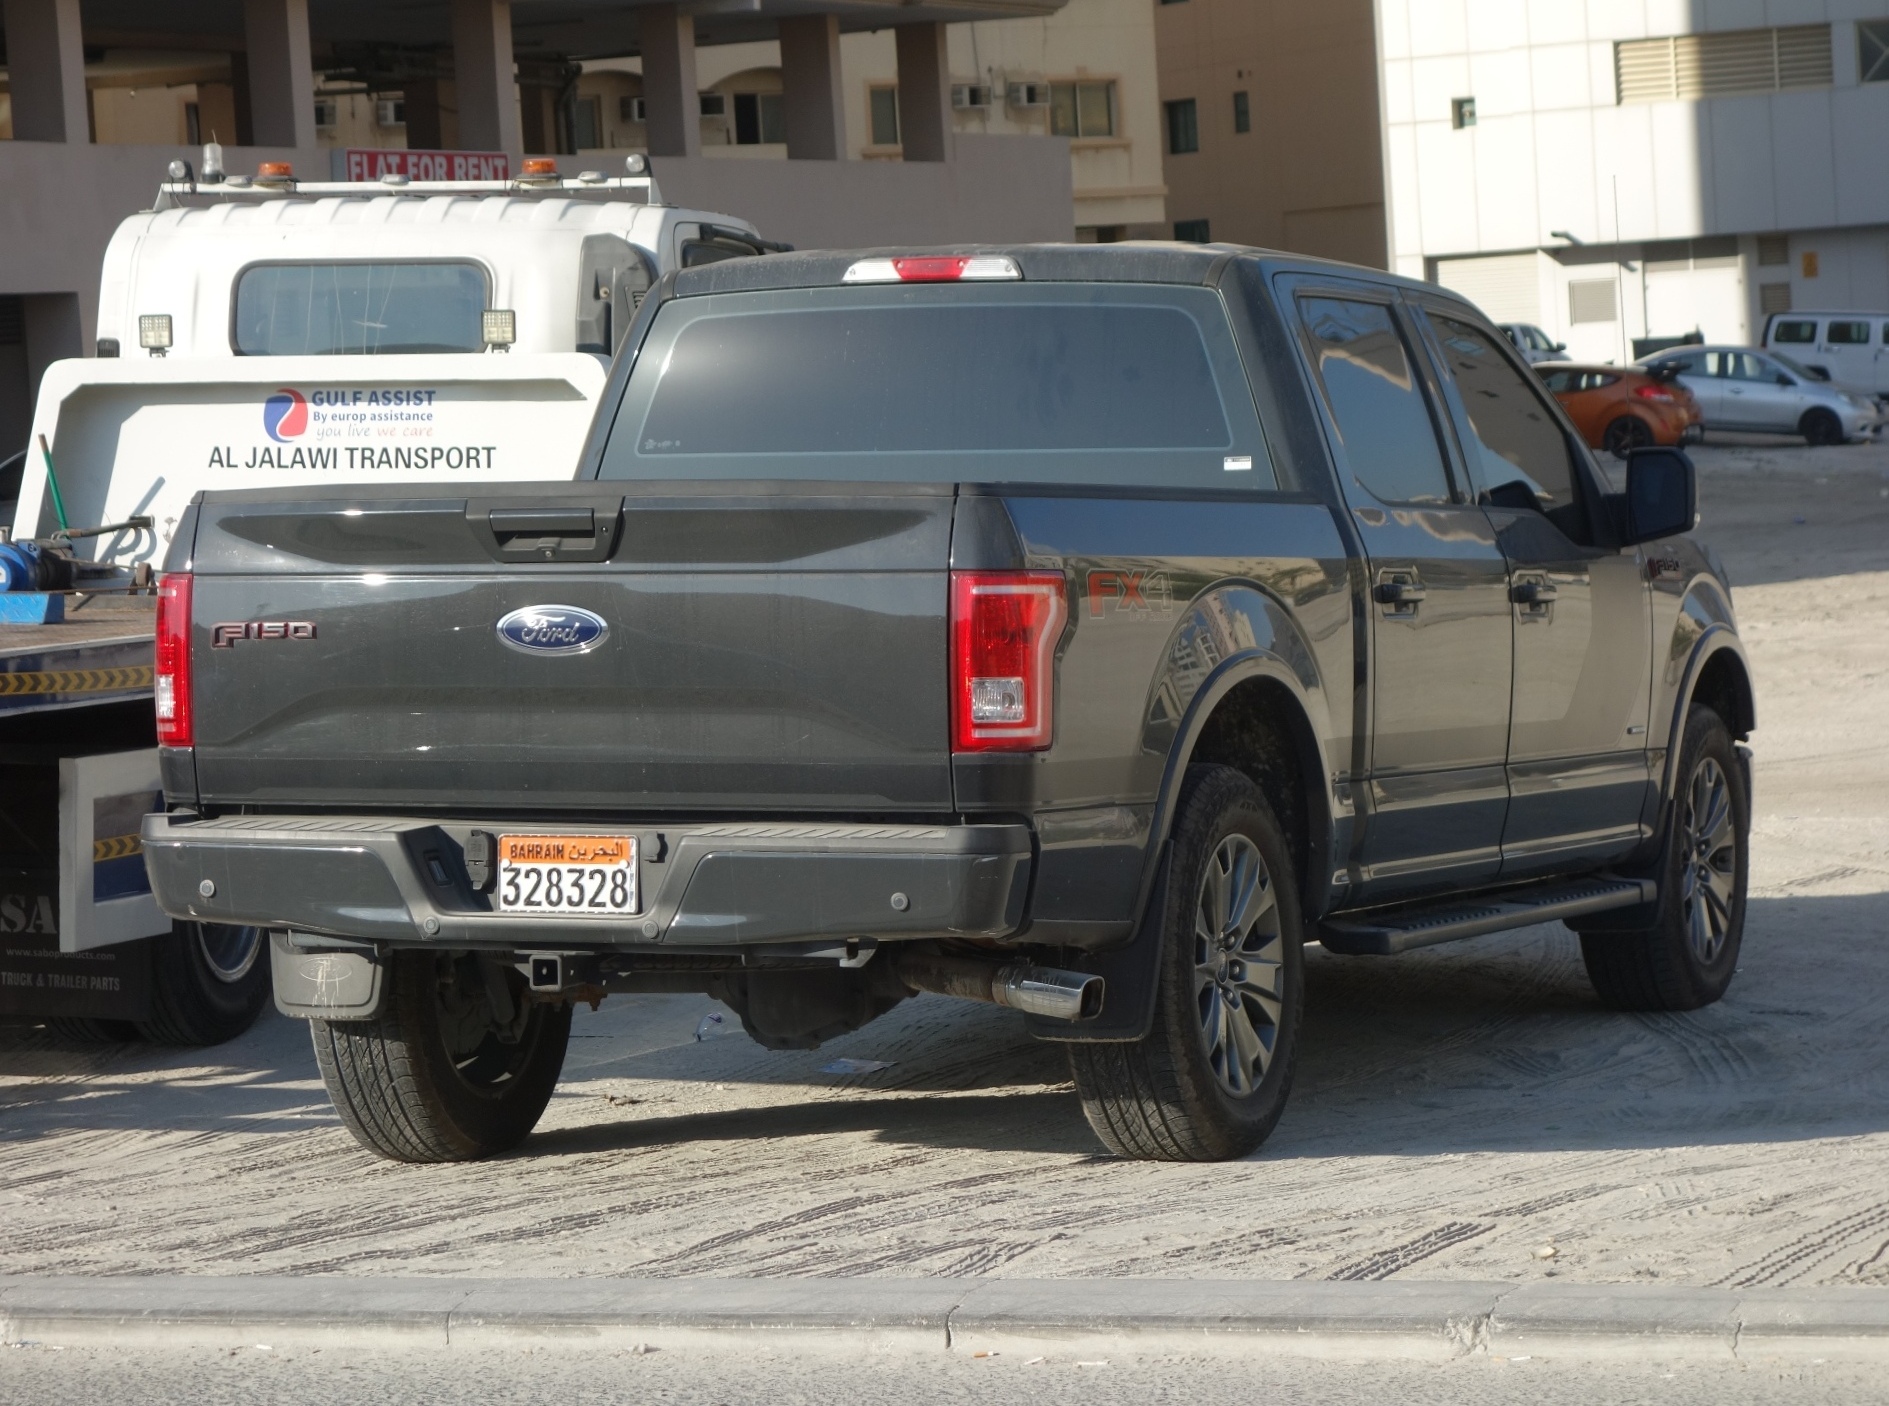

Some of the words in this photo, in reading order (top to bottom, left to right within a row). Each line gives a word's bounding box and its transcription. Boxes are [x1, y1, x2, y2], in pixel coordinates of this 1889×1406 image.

[350, 153, 400, 182] FLAT
[407, 154, 448, 182] FOR
[453, 155, 507, 181] RENT
[311, 390, 363, 407] GULF
[367, 390, 436, 407] ASSIST
[313, 411, 328, 424] By
[331, 412, 367, 423] europ
[370, 410, 433, 421] assistance
[316, 427, 341, 441] you
[348, 423, 370, 437] live
[377, 427, 397, 437] we
[402, 427, 433, 437] care
[208, 446, 238, 469] AL
[245, 446, 337, 469] JALAWI
[345, 446, 497, 469] TRANSPORT
[1086, 568, 1173, 619] FX4
[210, 621, 317, 649] F150
[521, 613, 581, 643] Ford
[510, 842, 565, 860] BAHRAIN
[568, 841, 624, 862] البحرين
[502, 867, 629, 908] 328328
[1, 971, 34, 987] TRUCK
[36, 973, 45, 987] &
[48, 973, 88, 989] TRAILER
[90, 976, 121, 992] PARTS
